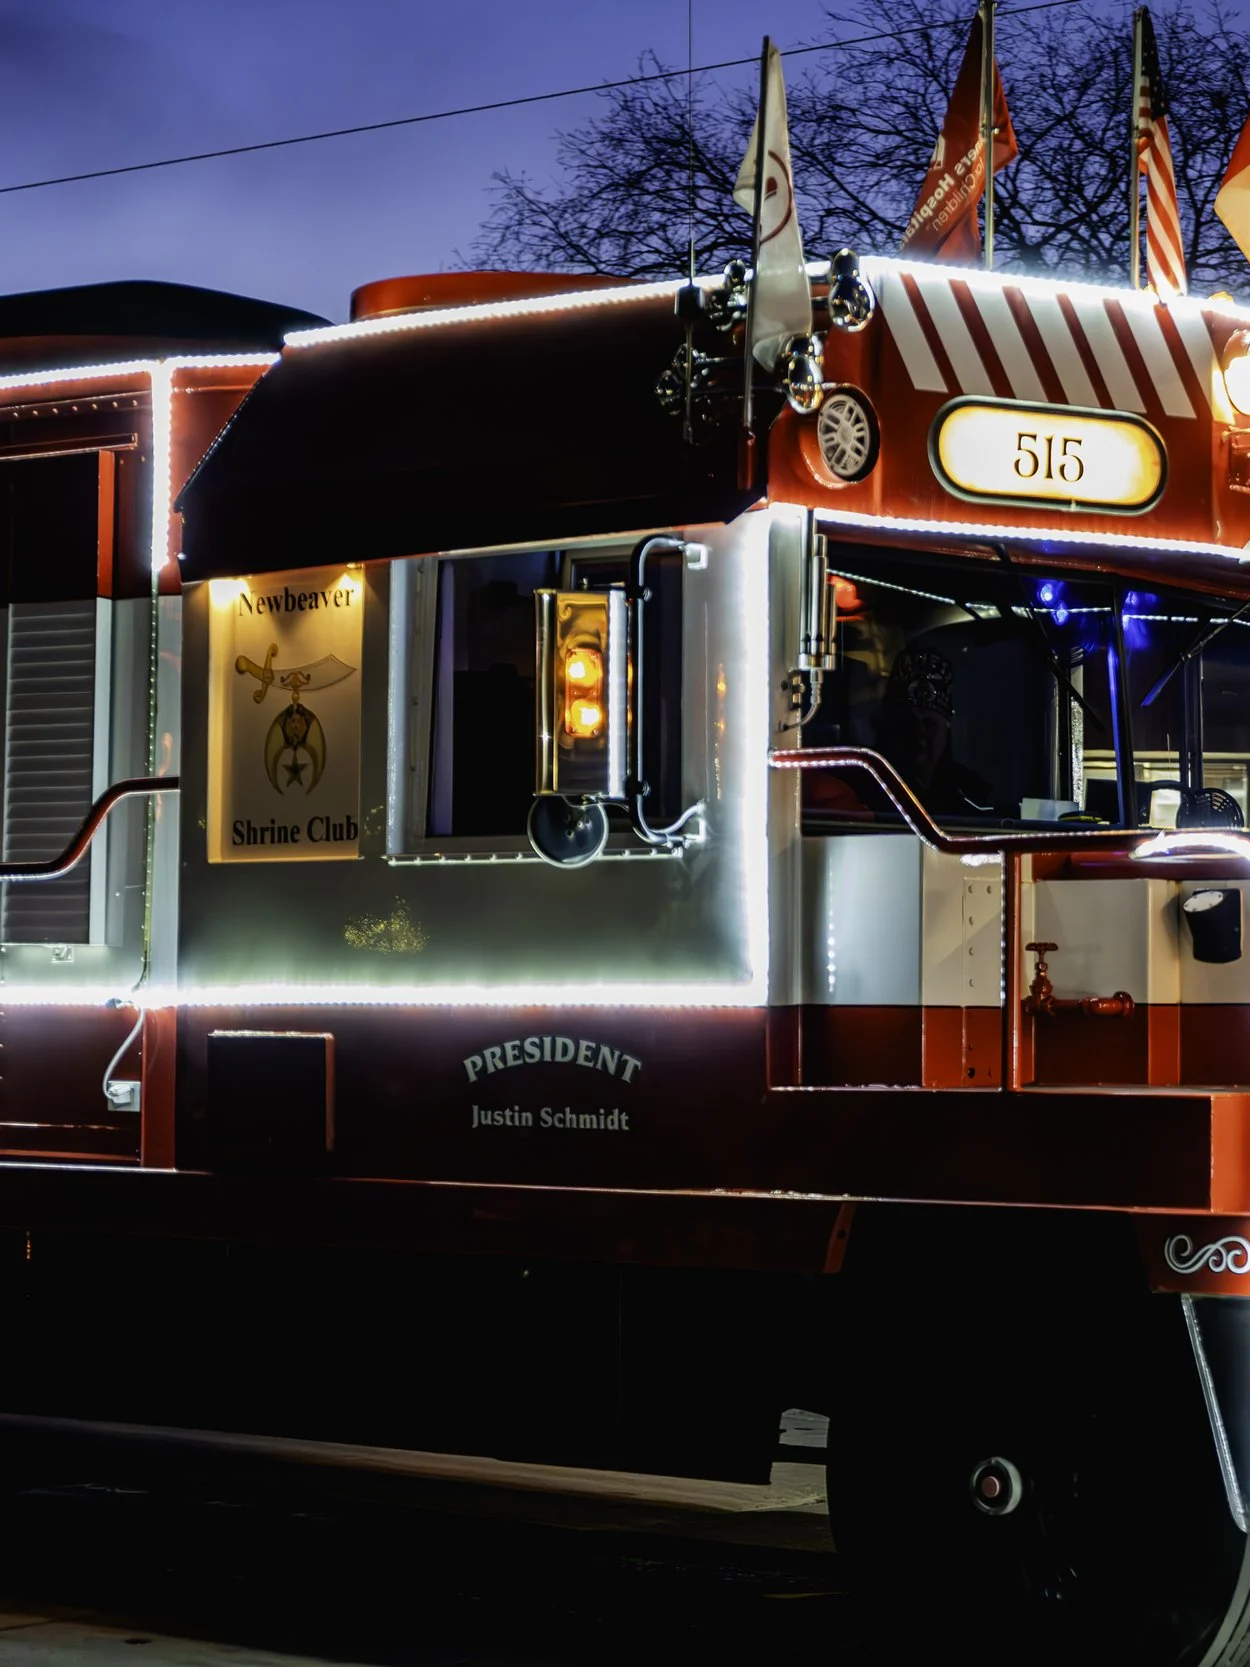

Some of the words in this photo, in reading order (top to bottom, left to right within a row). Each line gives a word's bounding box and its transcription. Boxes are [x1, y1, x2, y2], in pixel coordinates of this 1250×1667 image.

[1013, 432, 1085, 483] 515
[238, 586, 355, 617] Newbeaver
[231, 818, 301, 846] Shrine
[306, 814, 360, 843] Club
[462, 1035, 642, 1084] PRESIDENT
[471, 1104, 533, 1129] Justin
[539, 1106, 629, 1131] Schmidt
